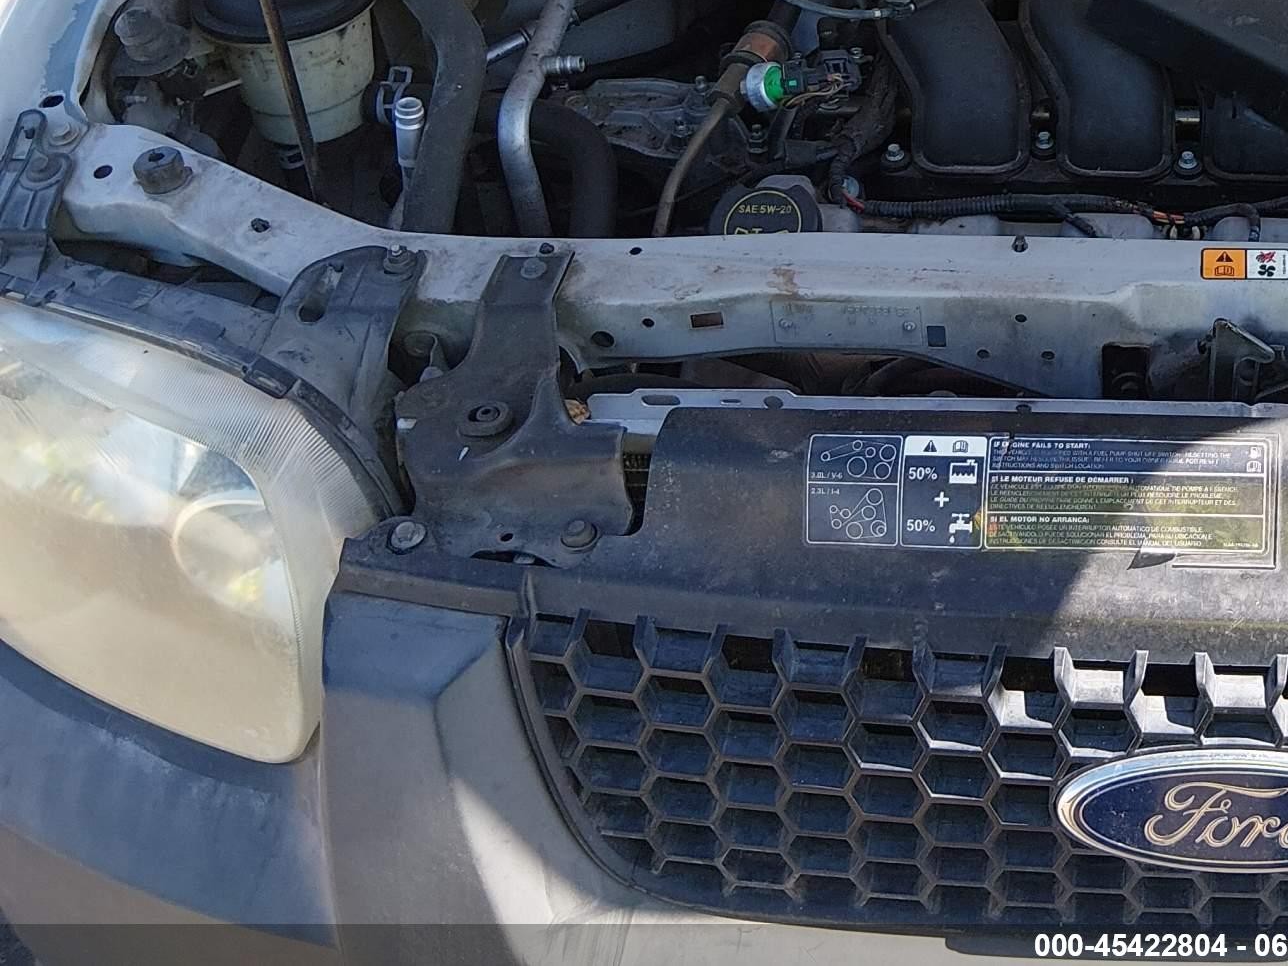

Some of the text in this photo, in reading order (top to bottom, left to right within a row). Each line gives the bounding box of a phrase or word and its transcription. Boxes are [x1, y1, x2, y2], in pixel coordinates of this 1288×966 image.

[739, 205, 791, 214] SAE 5W-20
[908, 467, 938, 480] 50%
[1000, 475, 1010, 483] LE
[1011, 475, 1043, 483] MOTEUR
[906, 519, 936, 532] 50%
